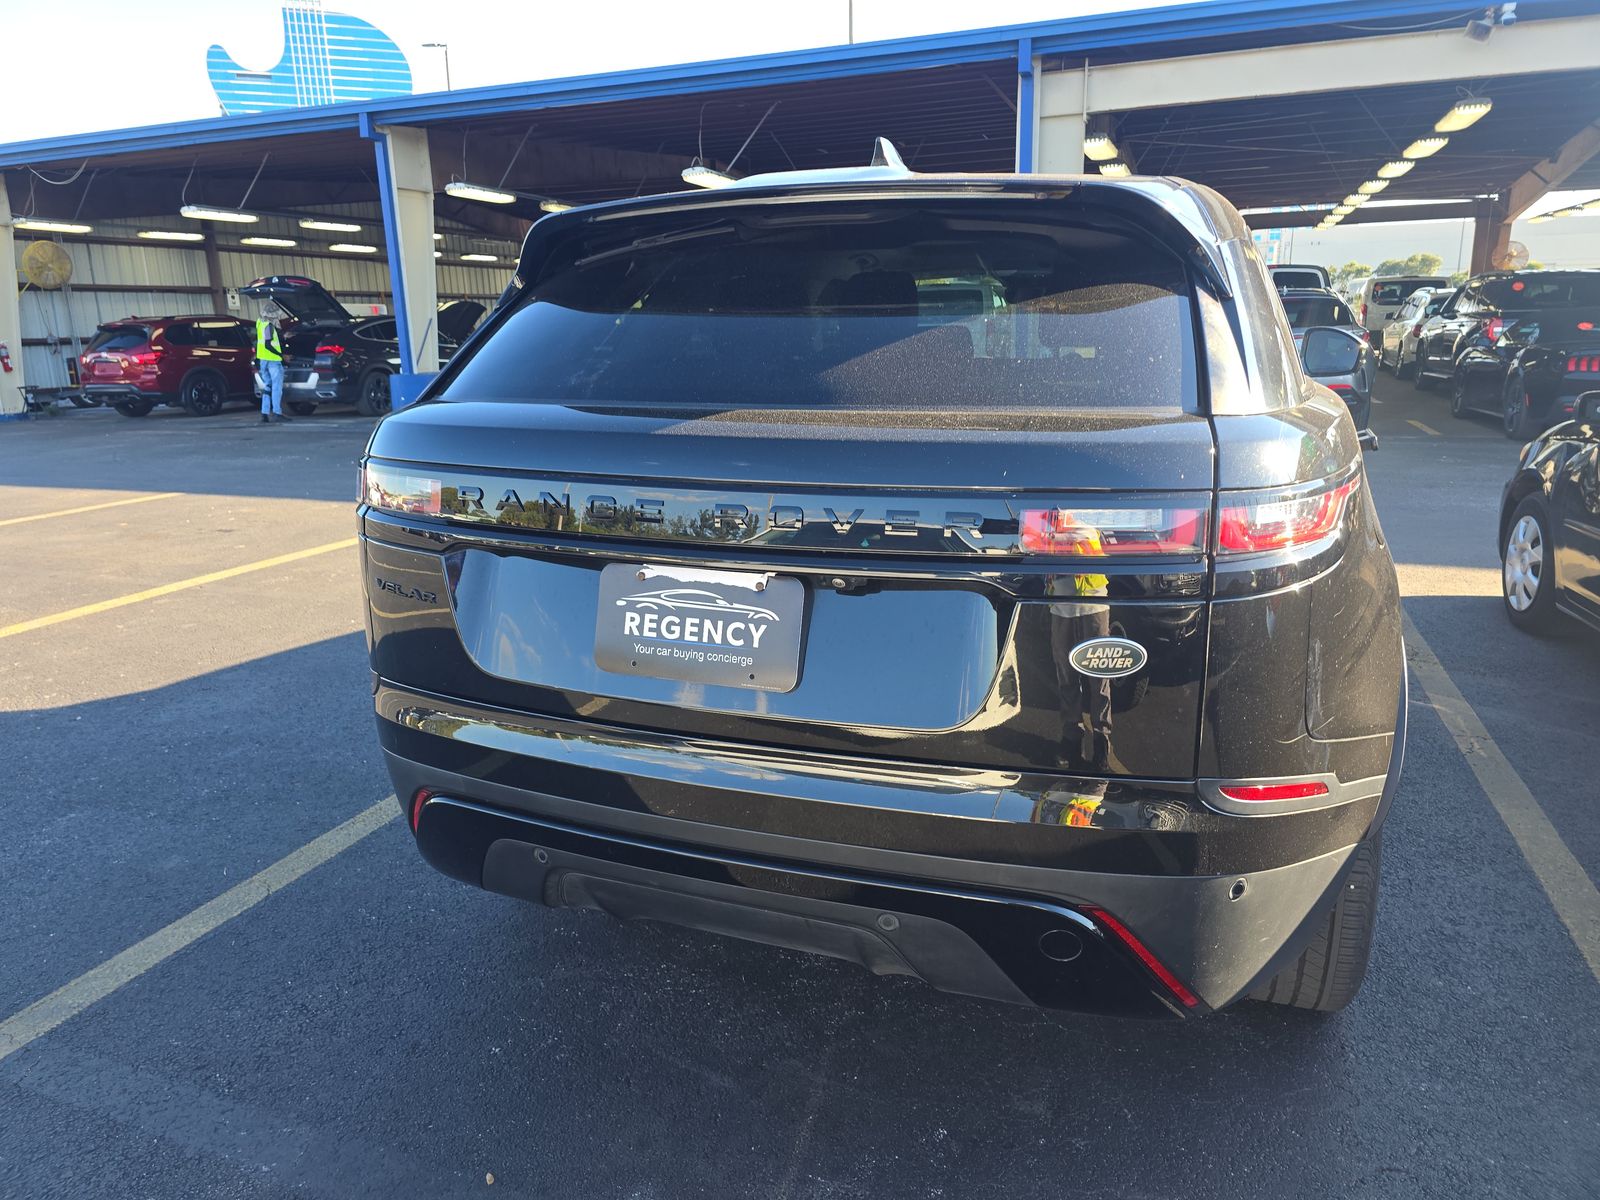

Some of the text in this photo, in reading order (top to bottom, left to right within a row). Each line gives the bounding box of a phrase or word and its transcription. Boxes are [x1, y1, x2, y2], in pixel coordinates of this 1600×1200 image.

[457, 484, 985, 540] RANGE ROVER
[376, 577, 438, 604] VELAR
[623, 611, 768, 649] REGENCY
[633, 642, 753, 666] Your car buying concierge
[1086, 647, 1123, 658] LAND
[1088, 657, 1134, 669] ROVER
